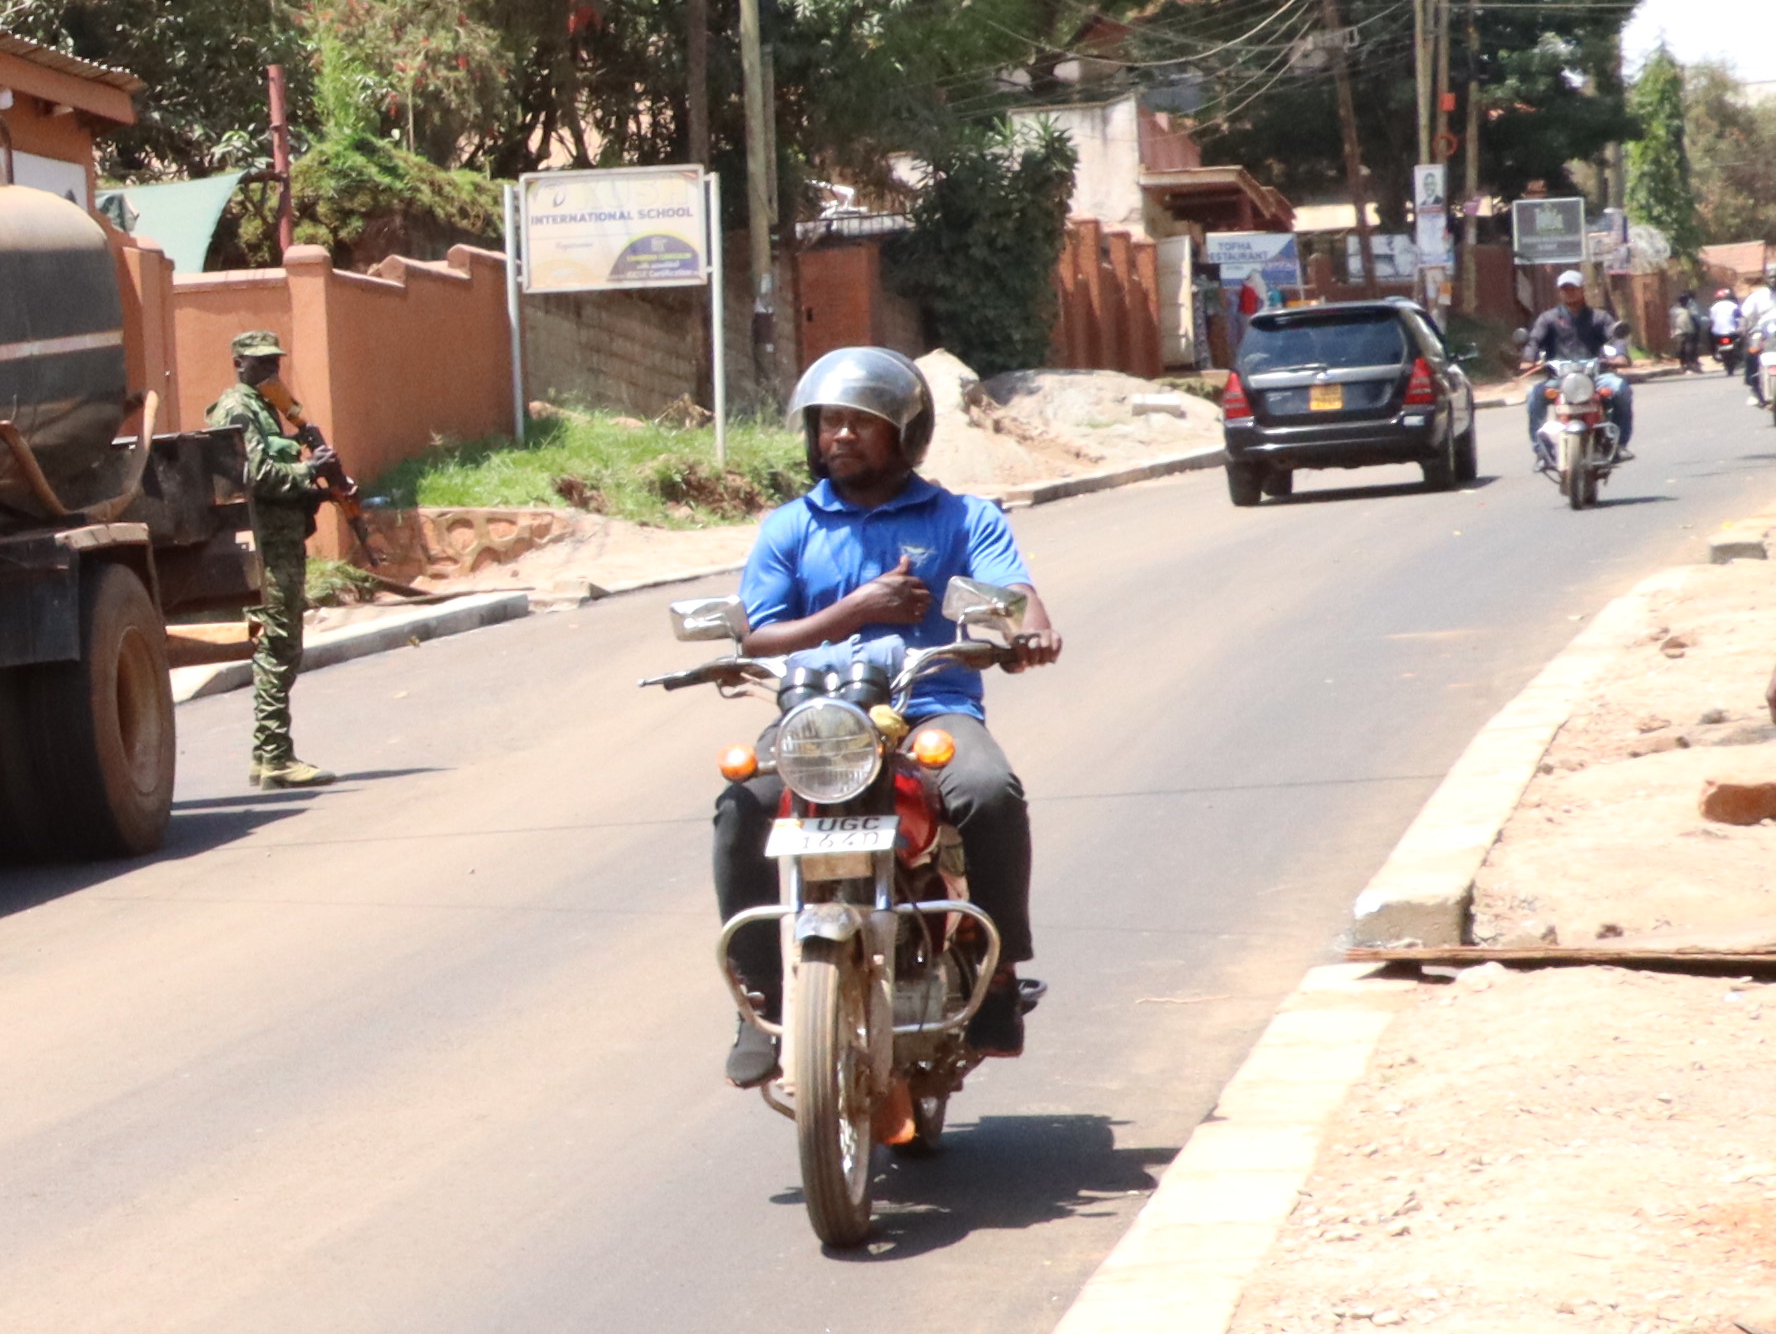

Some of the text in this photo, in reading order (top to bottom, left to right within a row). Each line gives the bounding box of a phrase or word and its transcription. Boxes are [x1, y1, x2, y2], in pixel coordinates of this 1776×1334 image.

[530, 206, 694, 226] INTERNATIONAL SCHOOL
[816, 816, 880, 832] UGC
